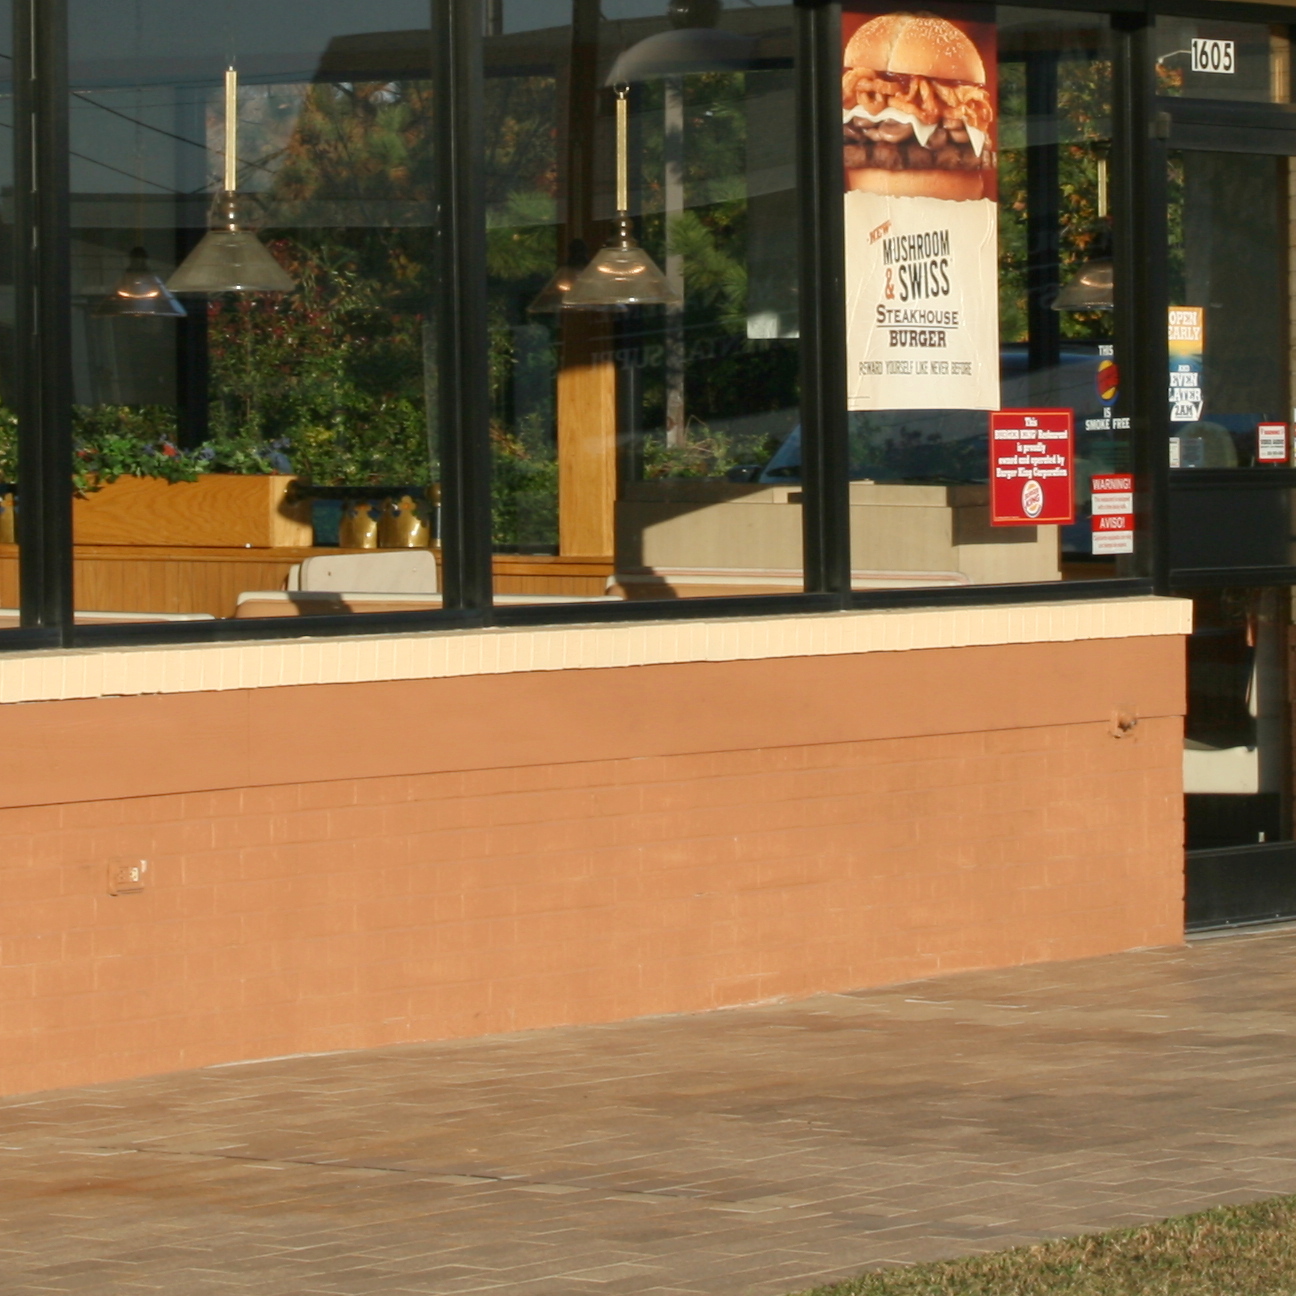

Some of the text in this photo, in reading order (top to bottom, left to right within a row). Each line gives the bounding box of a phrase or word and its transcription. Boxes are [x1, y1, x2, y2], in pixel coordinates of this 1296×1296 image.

[1192, 40, 1233, 72] 1605
[882, 228, 950, 266] MUSHROOM
[884, 257, 951, 303] & SWISS
[875, 303, 960, 325] STEAKHOUSE
[1168, 310, 1198, 326] OPEN
[888, 329, 948, 348] BURGER
[1168, 326, 1202, 341] EARLY
[1098, 345, 1114, 356] THIS
[1169, 372, 1198, 387] EVEN
[1168, 387, 1202, 403] LATER
[1104, 407, 1112, 418] IS
[1085, 417, 1131, 431] SMOKE FREE
[1092, 477, 1132, 491] WARNING!
[1099, 516, 1126, 530] AVISO!
